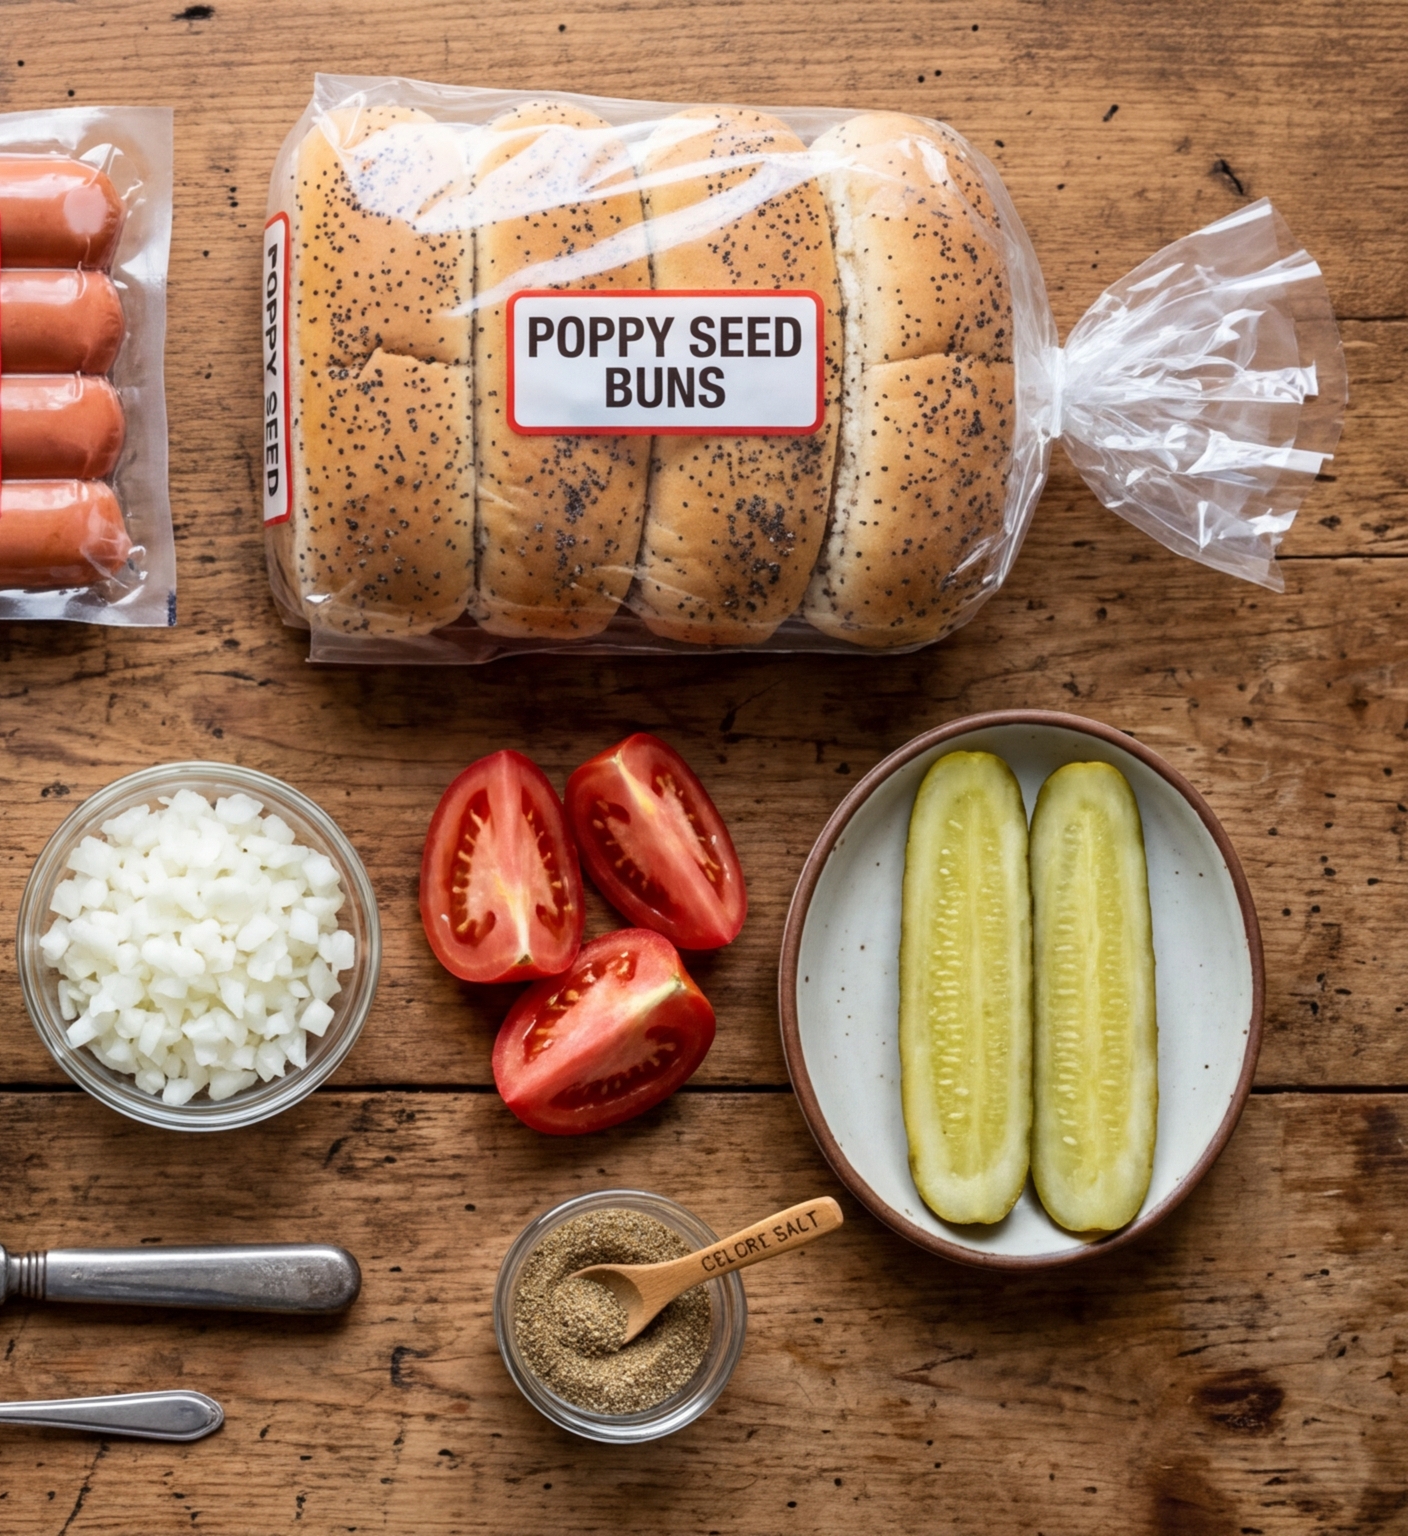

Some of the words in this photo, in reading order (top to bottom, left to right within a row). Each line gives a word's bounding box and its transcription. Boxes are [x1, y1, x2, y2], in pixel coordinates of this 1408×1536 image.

[526, 315, 675, 359] POPPY
[688, 315, 803, 359] SEED
[604, 366, 727, 409] BUNS
[772, 1210, 819, 1243] SALT
